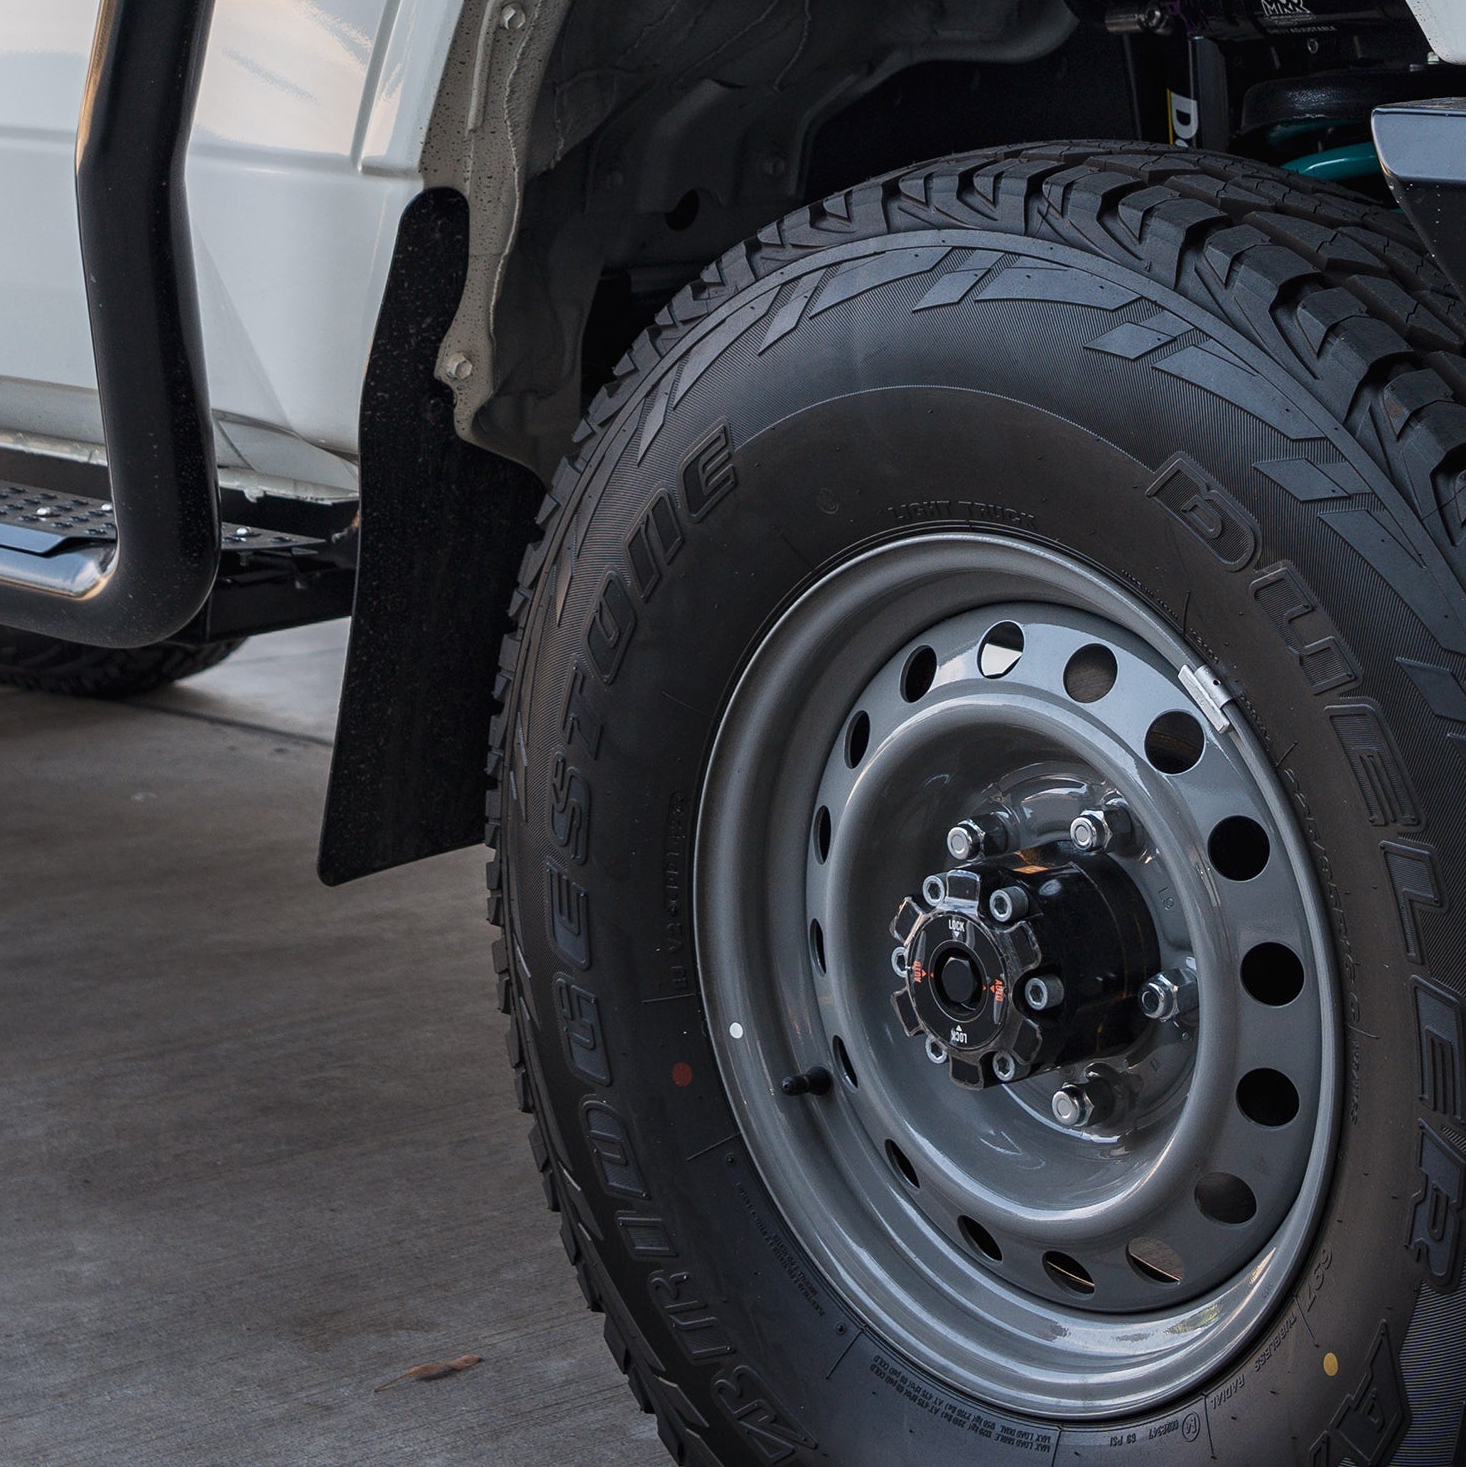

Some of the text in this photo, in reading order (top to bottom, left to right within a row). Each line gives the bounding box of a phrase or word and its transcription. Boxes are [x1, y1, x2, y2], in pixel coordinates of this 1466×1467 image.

[546, 417, 819, 1466] BRIDGESTONE
[948, 919, 965, 933] LOCK
[950, 1030, 968, 1044] LOCK
[1209, 1311, 1298, 1410] TUBELESS RADIAL
